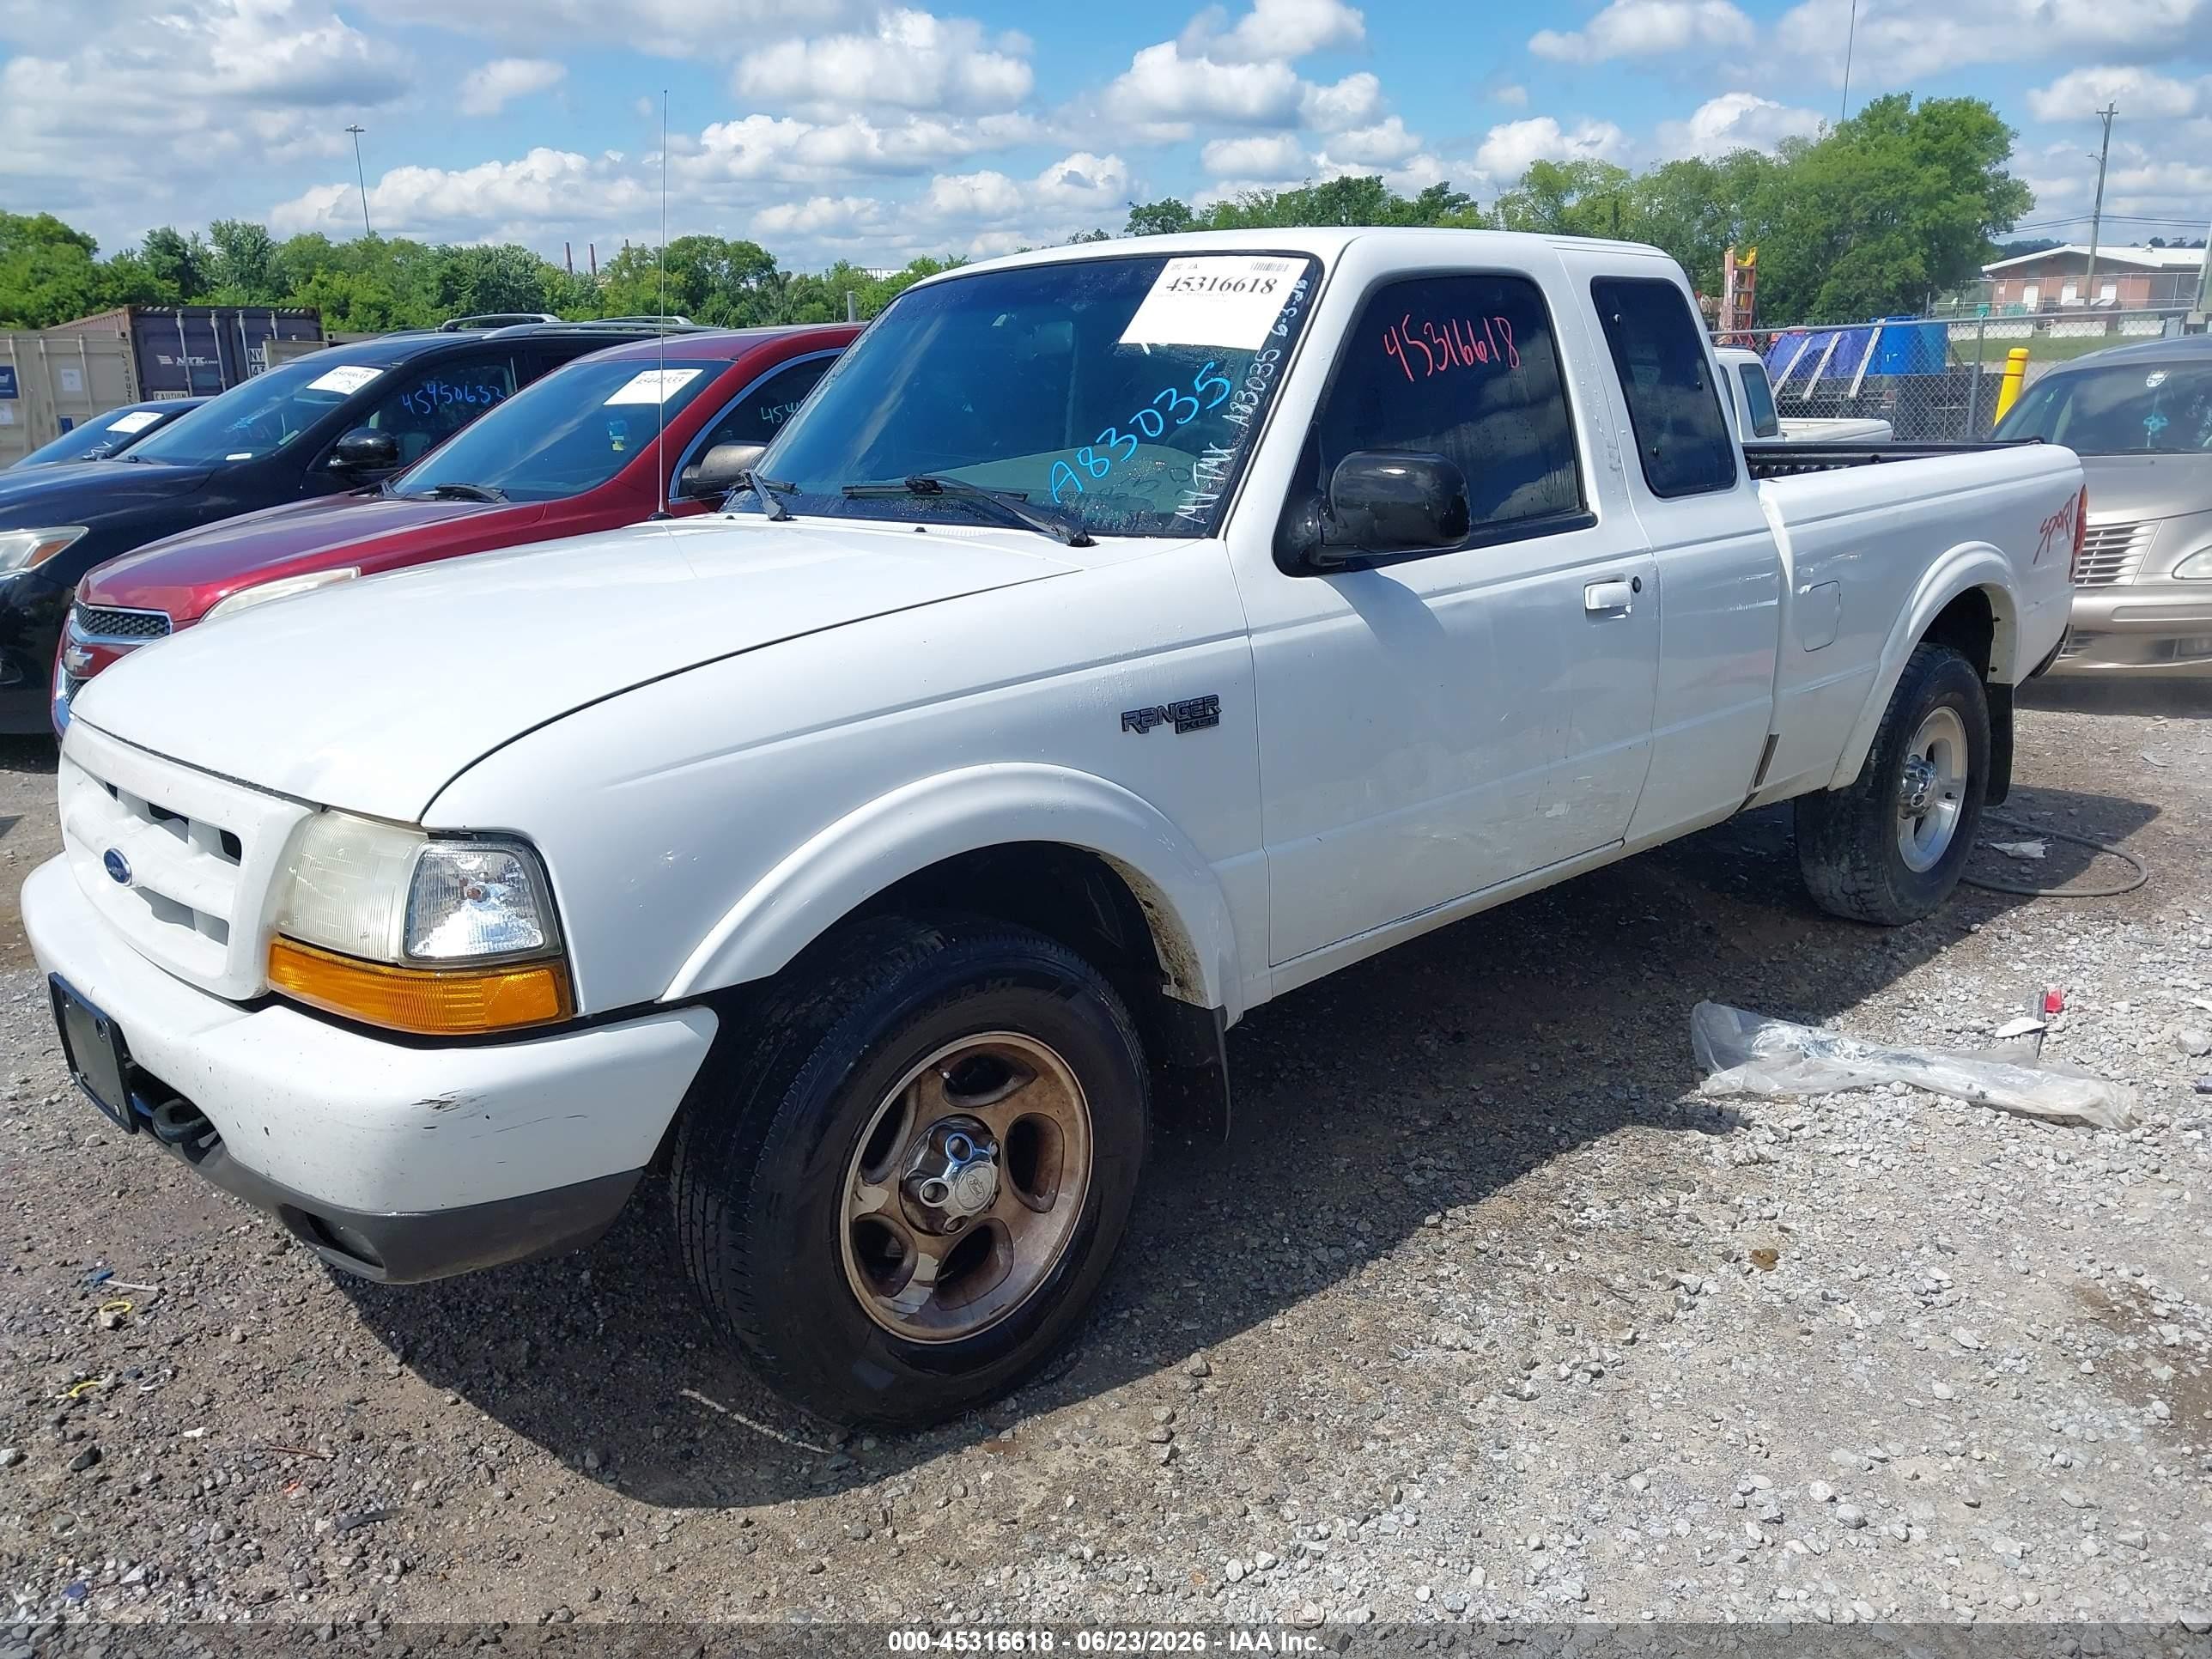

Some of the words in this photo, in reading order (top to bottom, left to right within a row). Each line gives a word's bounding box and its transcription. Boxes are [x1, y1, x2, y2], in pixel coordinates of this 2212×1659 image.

[1165, 276, 1278, 294] 45316618
[1383, 313, 1520, 382] 45316618
[1221, 348, 1281, 428] A83035
[1051, 361, 1231, 504] A83035
[2033, 492, 2076, 565] SPORT
[1121, 694, 1222, 734] RANGER
